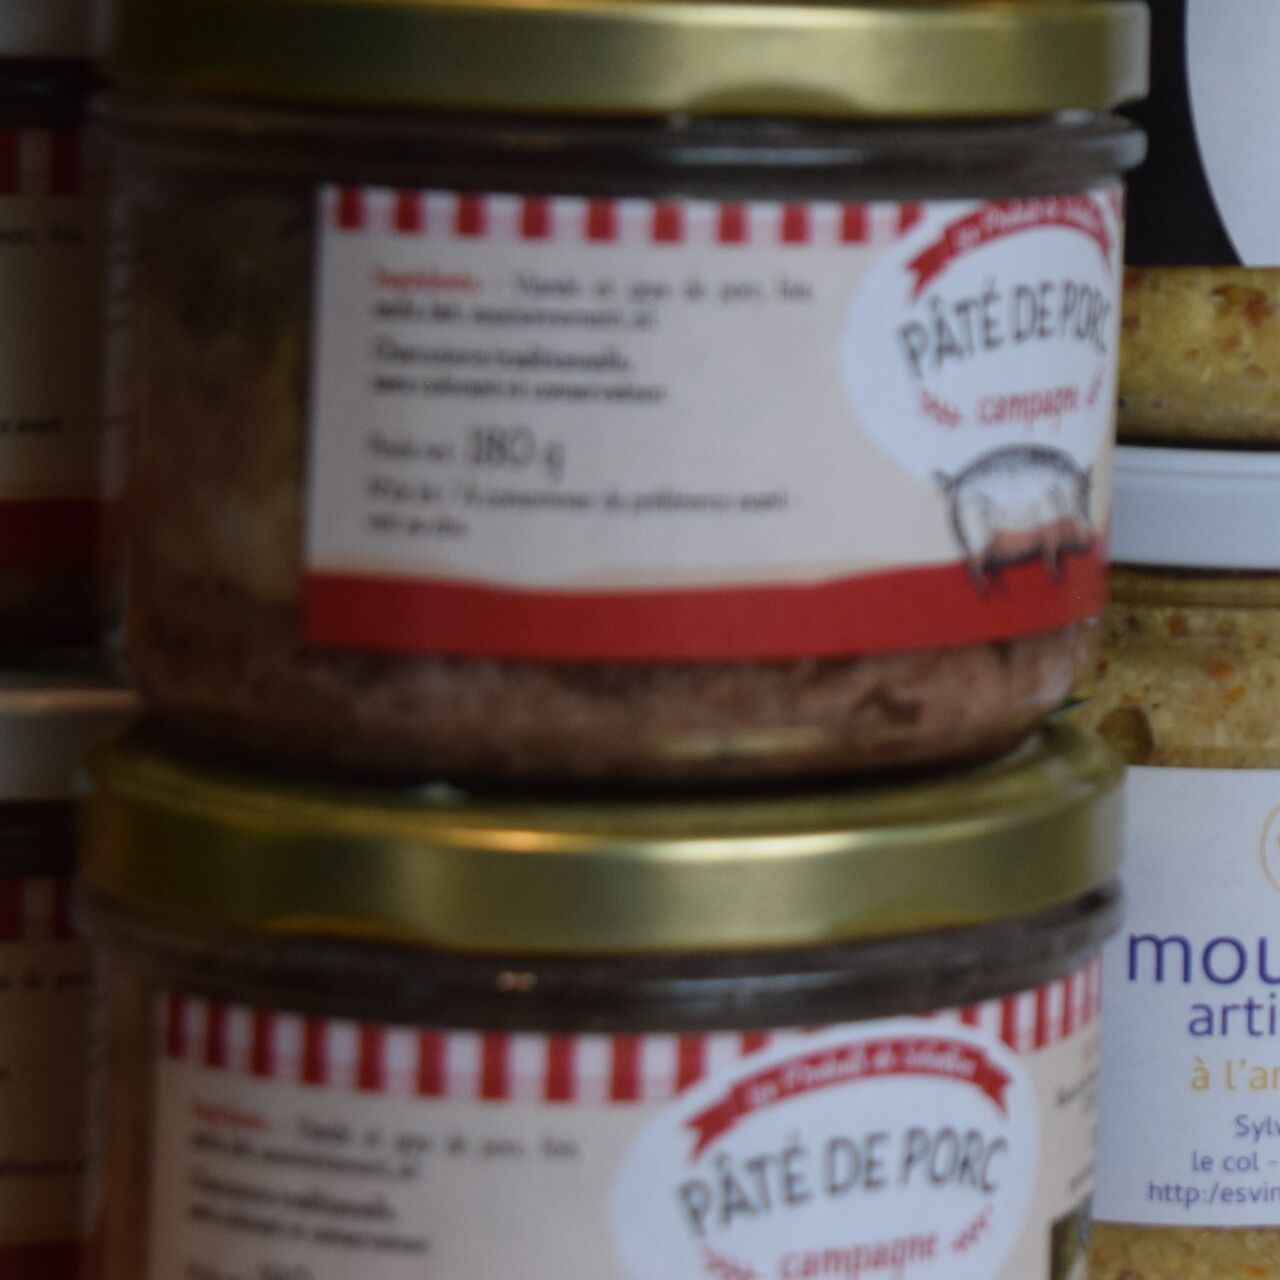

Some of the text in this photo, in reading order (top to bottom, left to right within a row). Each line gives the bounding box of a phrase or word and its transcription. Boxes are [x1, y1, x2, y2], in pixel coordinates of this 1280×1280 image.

[899, 275, 1004, 380] PÂTÉ
[1012, 281, 1055, 343] DE
[1189, 1056, 1211, 1092] à
[678, 1124, 1009, 1238] PÂTÉ DE PORC
[1191, 1150, 1213, 1172] le
[1223, 1149, 1259, 1172] col
